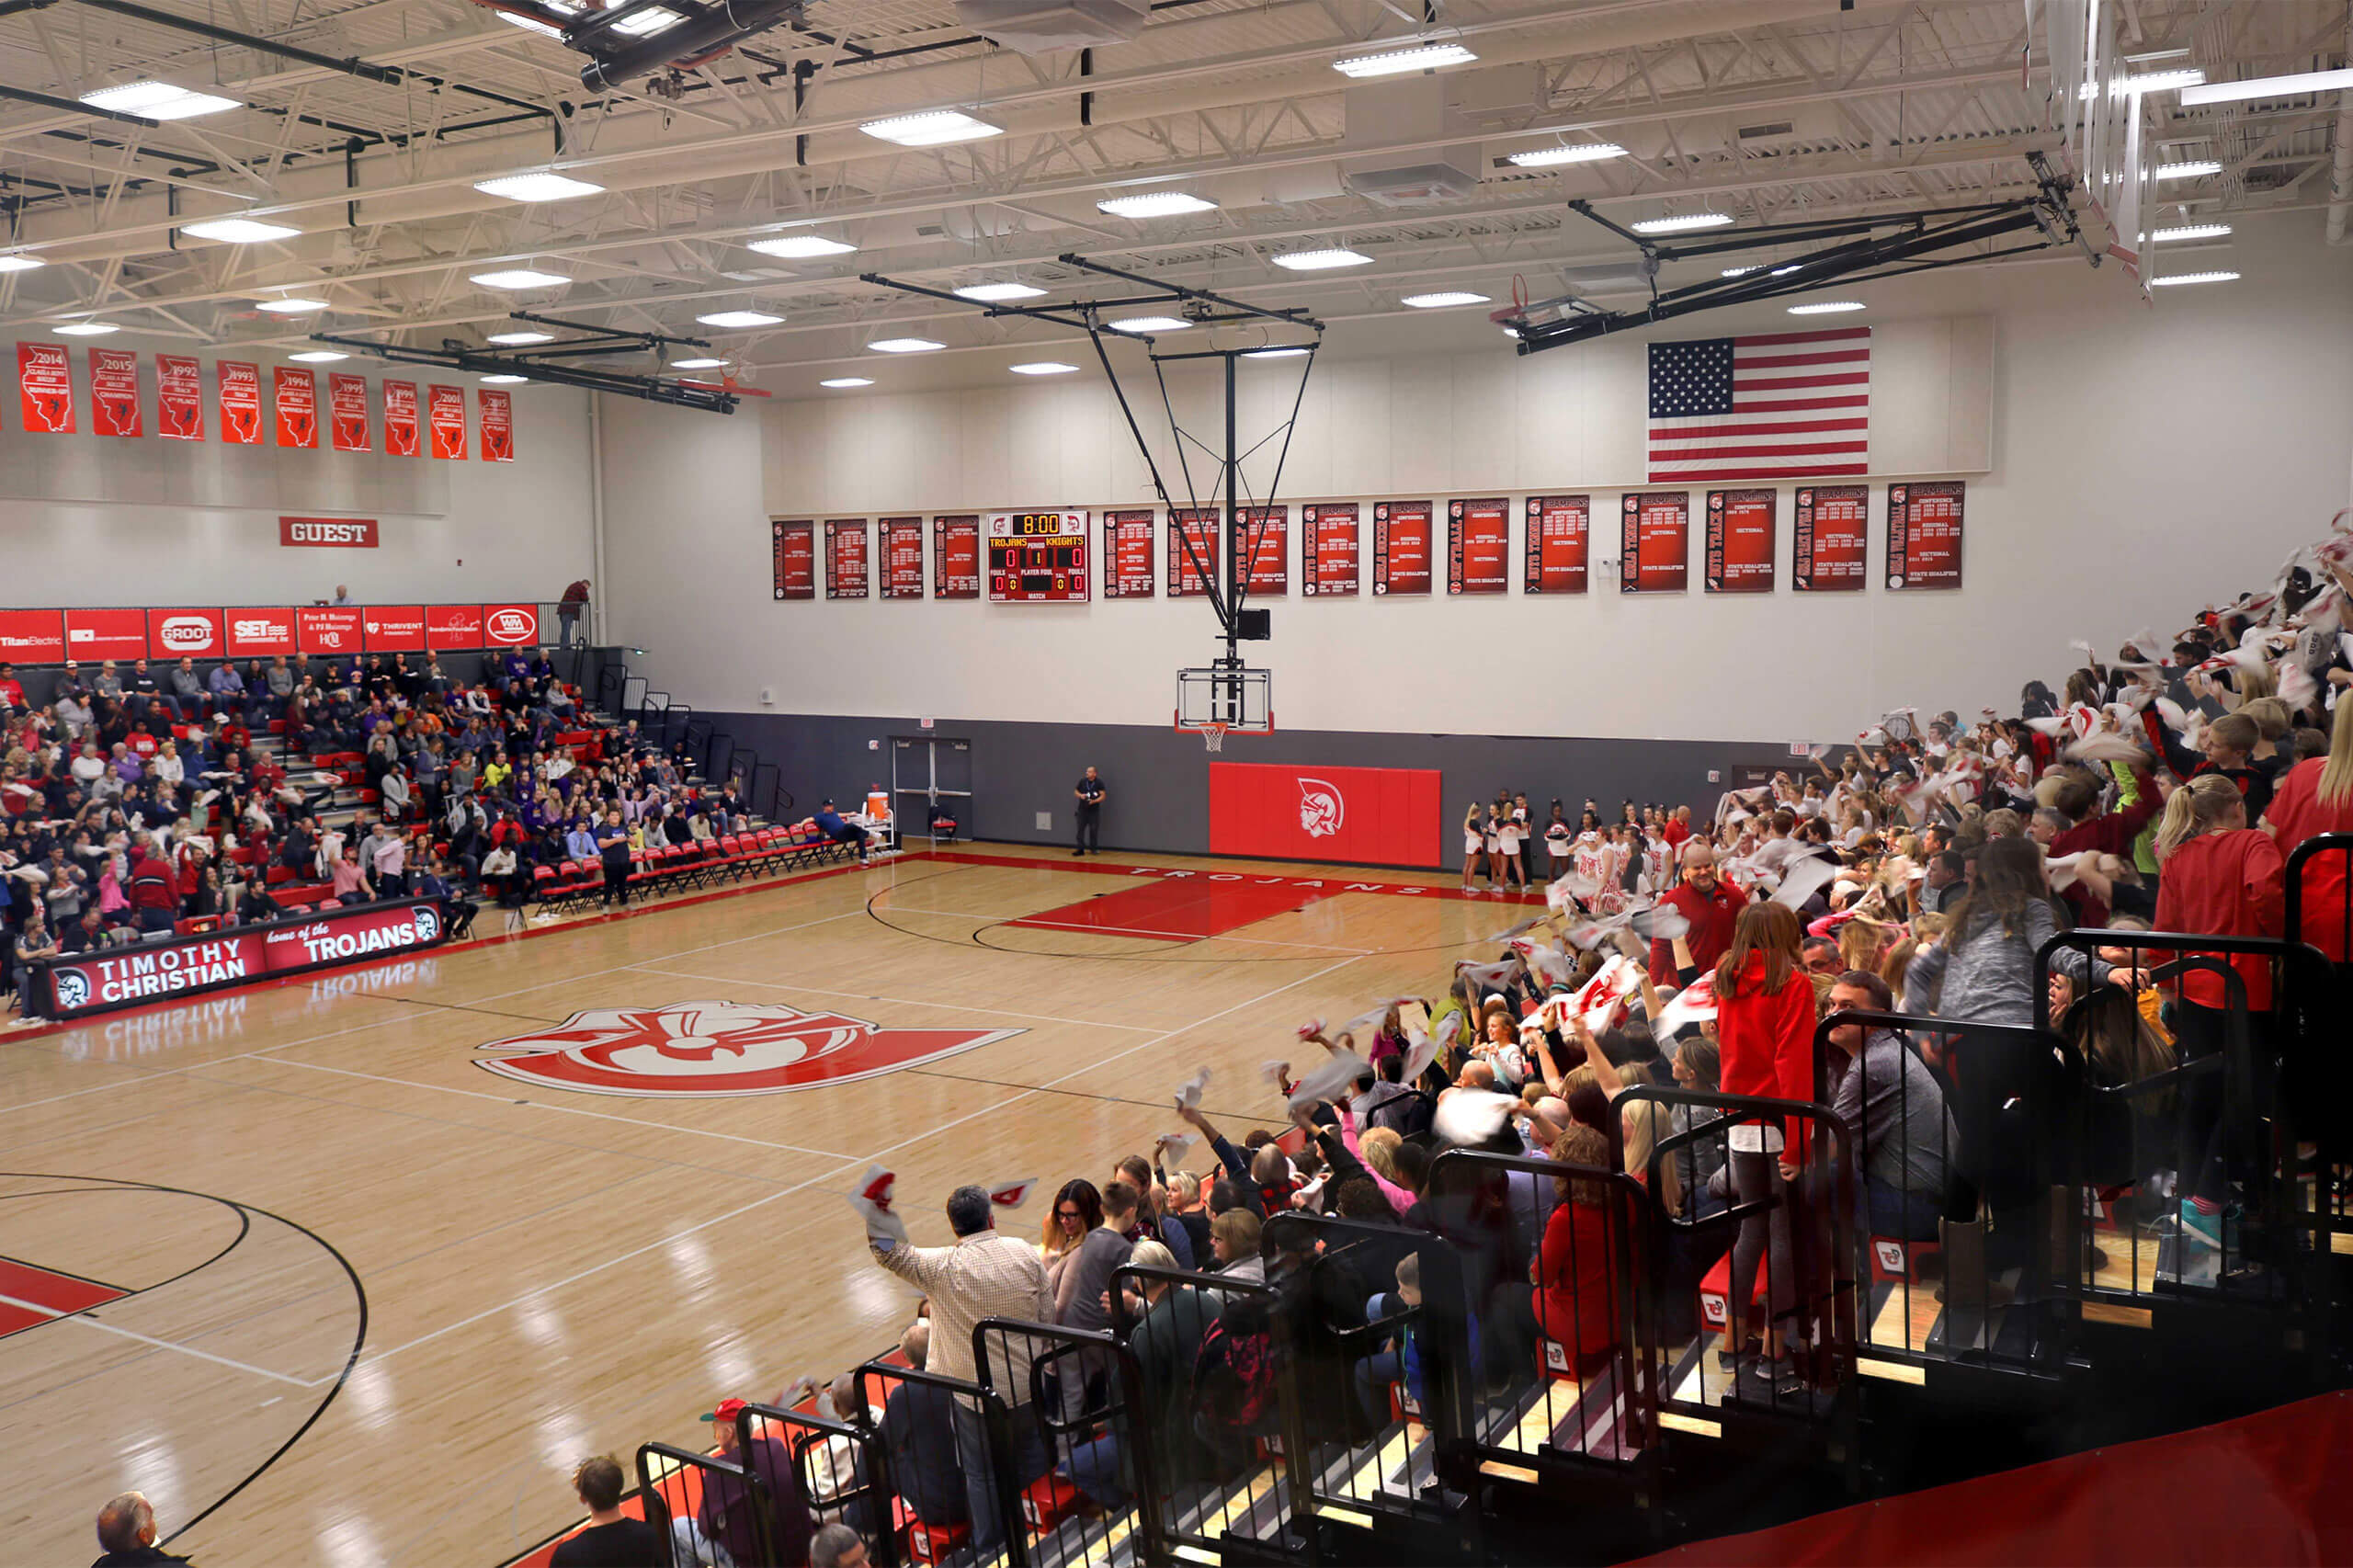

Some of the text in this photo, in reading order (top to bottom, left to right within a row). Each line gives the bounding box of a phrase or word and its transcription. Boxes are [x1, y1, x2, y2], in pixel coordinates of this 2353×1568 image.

[37, 353, 63, 364] 2014
[106, 359, 132, 371] 2015
[173, 367, 199, 377] 1992
[233, 370, 254, 381] 1993
[288, 377, 309, 386] 1994
[344, 383, 364, 393] 1995
[441, 393, 460, 403] 2001
[1815, 489, 1868, 500] CHAMPIONS
[1910, 485, 1963, 496] CHAMPIONS
[1024, 516, 1059, 533] 8:00
[290, 523, 368, 542] GUEST
[1046, 537, 1085, 546] KNIGHTS
[1450, 520, 1463, 581] SOFTBALL
[1006, 550, 1016, 567] 0
[1072, 548, 1082, 566] 0
[996, 575, 1083, 590] 0 0 0 0
[234, 620, 270, 636] SET
[382, 622, 423, 631] THRIVENT
[161, 627, 213, 640] GROOT
[1131, 868, 1427, 894] TROJANS
[267, 922, 329, 945] home of the
[305, 923, 415, 963] TROJANS
[97, 939, 241, 982] TIMOTHY
[101, 960, 245, 1003] CHRISTIAN
